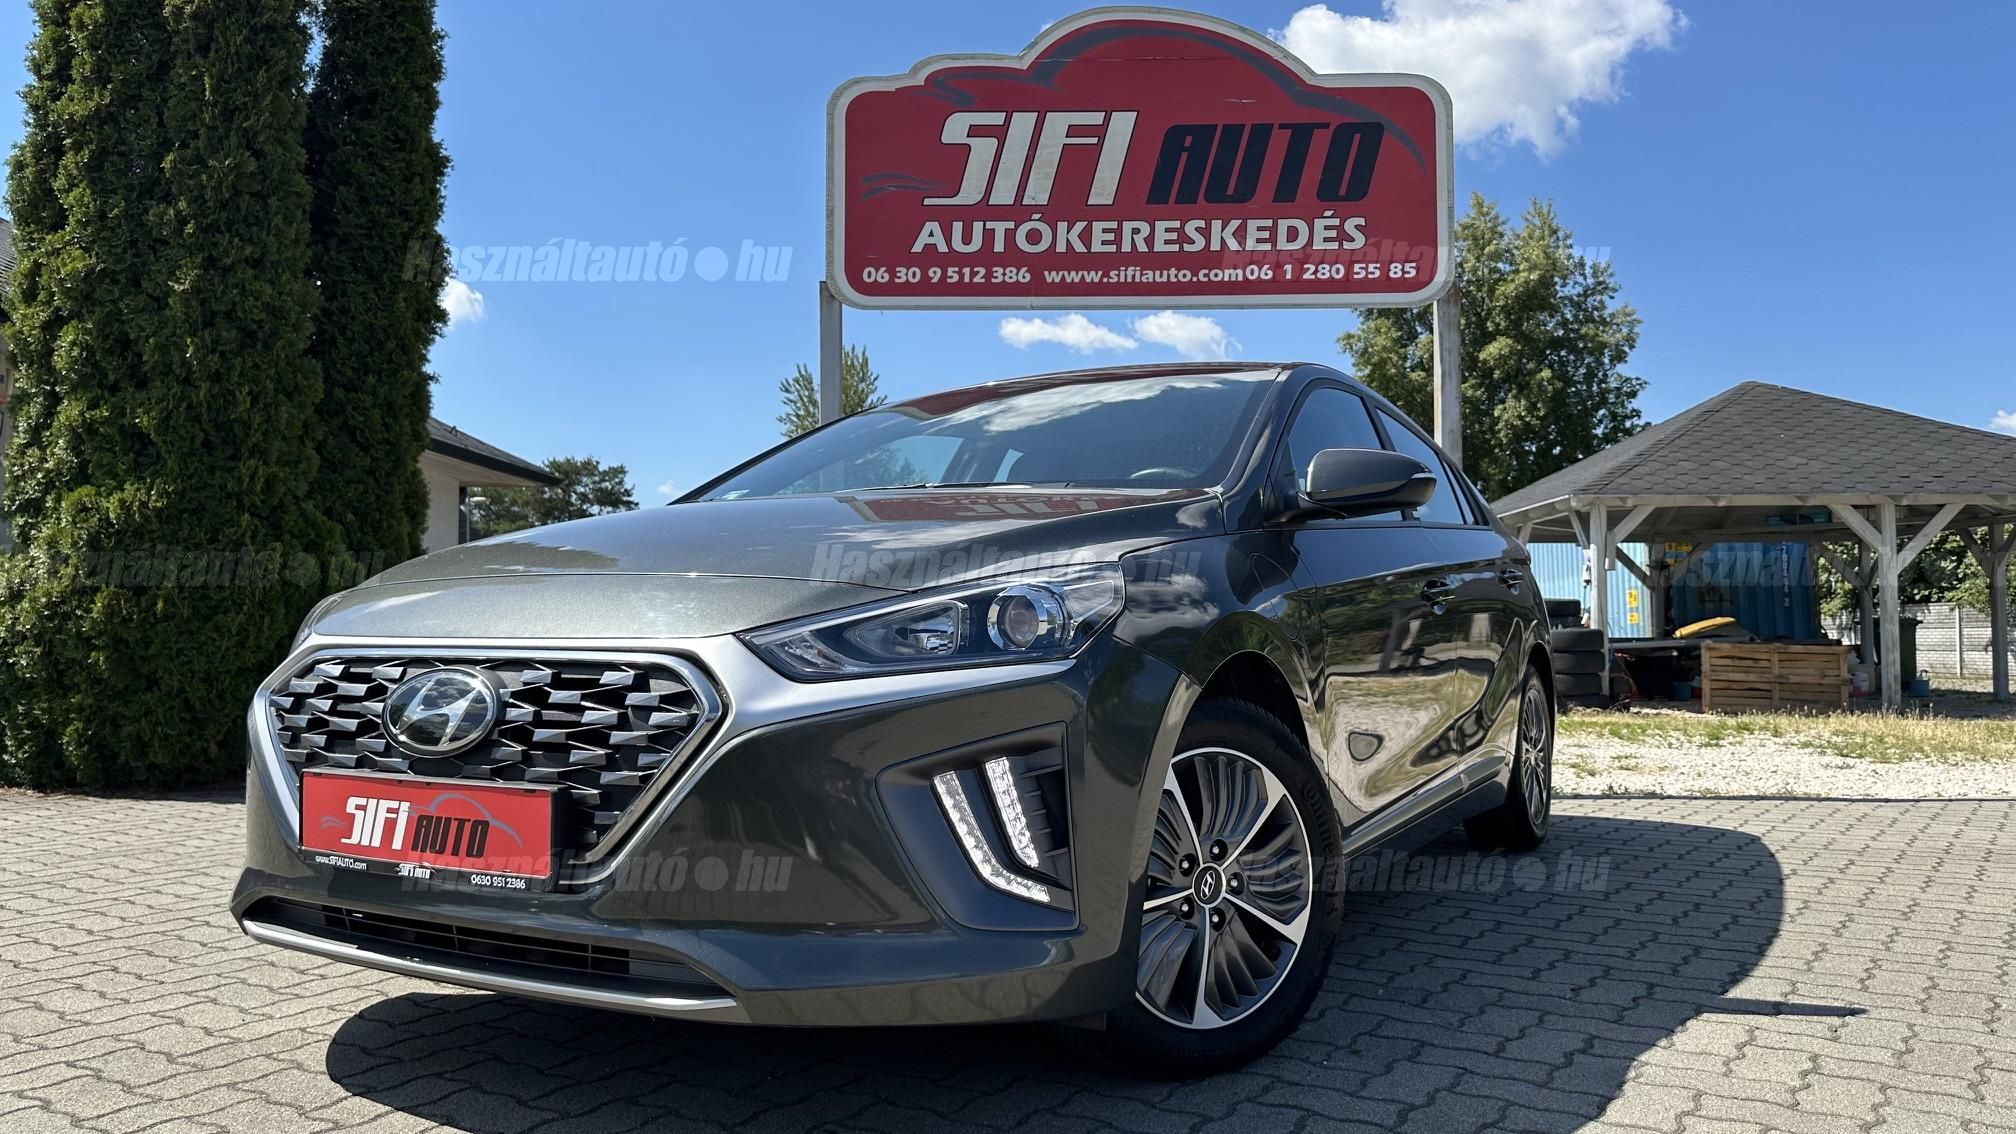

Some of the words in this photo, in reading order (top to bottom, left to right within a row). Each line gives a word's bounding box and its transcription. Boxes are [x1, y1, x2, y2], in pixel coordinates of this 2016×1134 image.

[922, 110, 1139, 207] SIFI
[1146, 121, 1386, 205] AUTO
[909, 210, 1368, 254] AUTÓKERESKEDÉS
[862, 266, 890, 283] 06
[894, 266, 922, 283] 30
[990, 266, 1031, 283] 386
[1043, 266, 1243, 283] www.sifiauto.com
[1245, 264, 1274, 280] 06
[1283, 264, 1294, 280] 1
[1302, 263, 1345, 280] 280
[1353, 263, 1381, 279] 55
[1388, 262, 1417, 278] 85
[411, 814, 490, 858] AUTO
